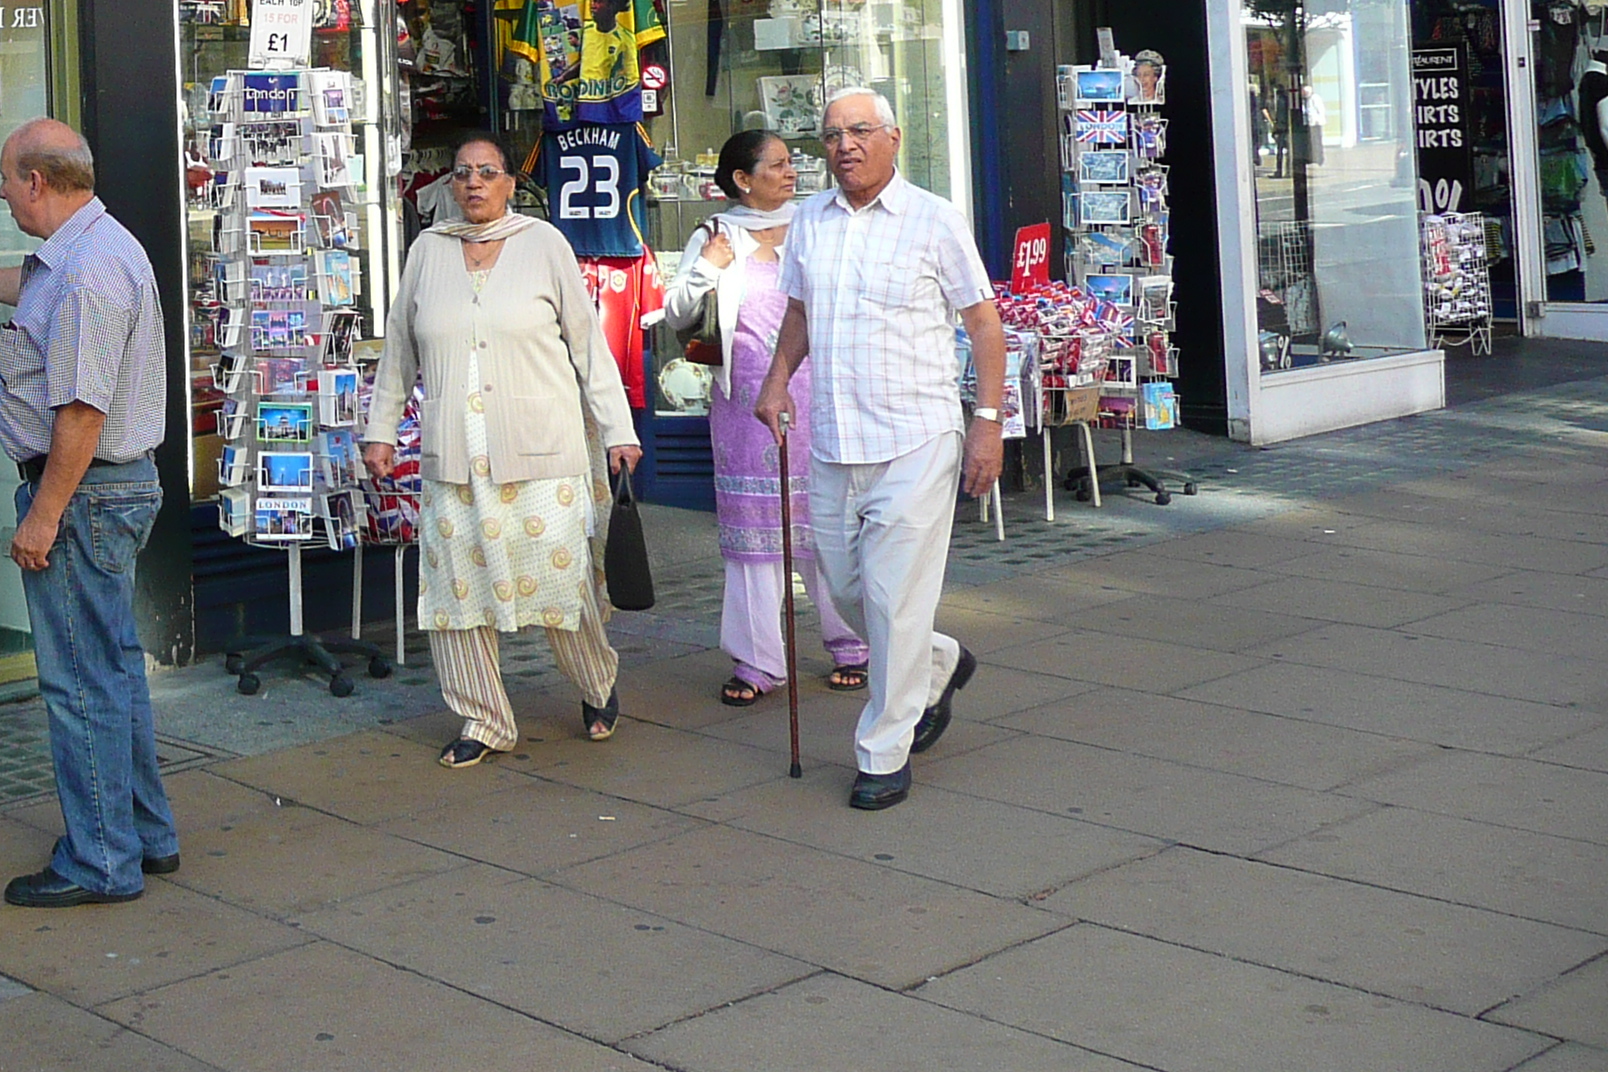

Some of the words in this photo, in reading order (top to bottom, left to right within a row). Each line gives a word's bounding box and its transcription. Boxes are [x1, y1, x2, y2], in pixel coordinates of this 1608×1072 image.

[278, 14, 298, 24] FOR
[267, 33, 288, 52] £1
[557, 127, 620, 151] BECKHAM
[560, 155, 620, 219] 23
[1016, 238, 1046, 277] £1.99
[259, 501, 306, 509] LONDON
